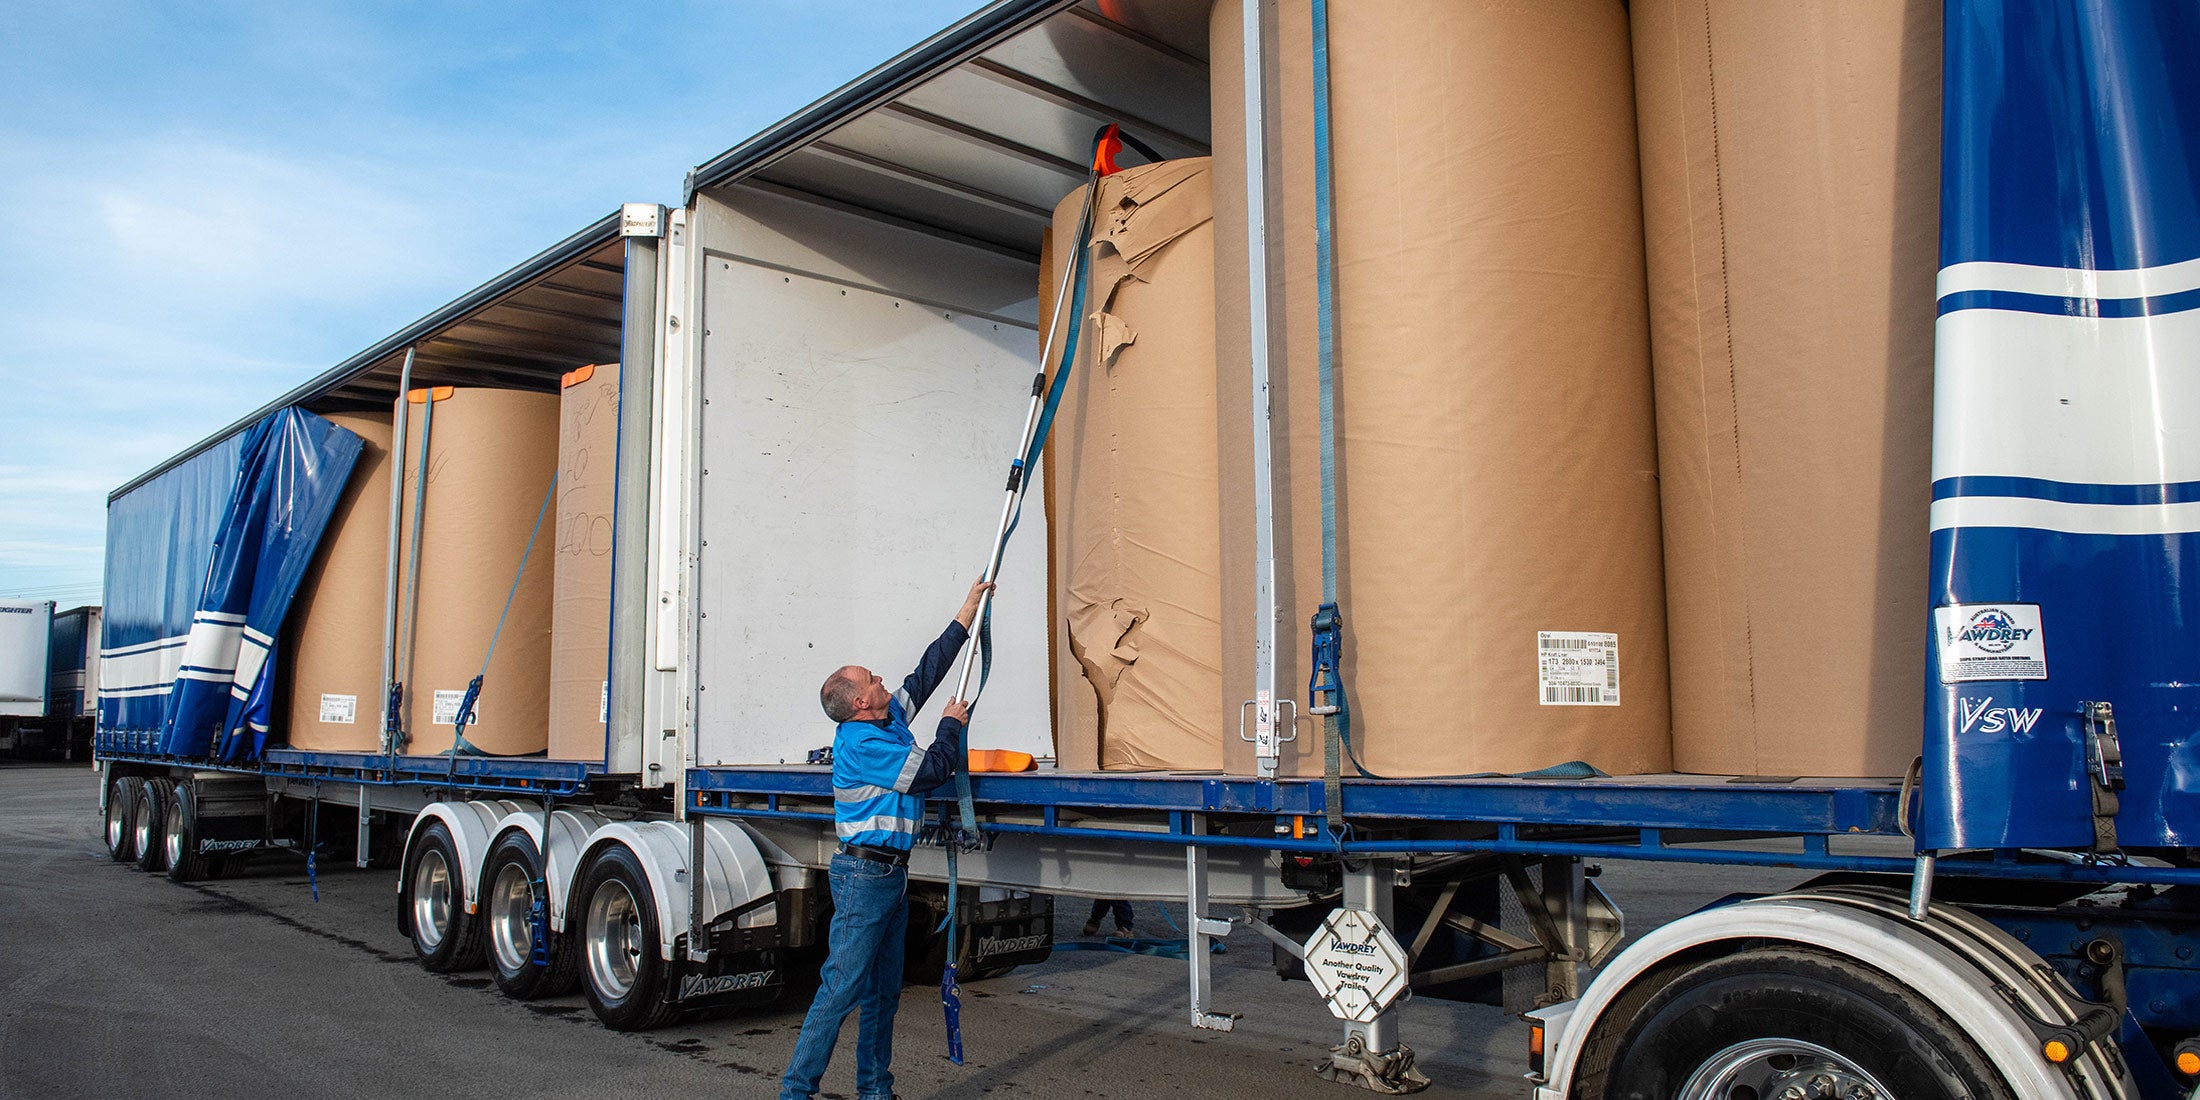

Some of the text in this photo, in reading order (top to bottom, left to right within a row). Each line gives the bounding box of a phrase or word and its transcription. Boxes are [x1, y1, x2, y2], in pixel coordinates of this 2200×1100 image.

[199, 838, 261, 855] VAWDREY
[977, 934, 1048, 963] VAWDREY
[1330, 938, 1377, 954] VAWDREY
[1322, 958, 1384, 976] Another Quality
[1336, 970, 1370, 984] Vawdrey
[677, 969, 775, 1003] VAWDREY
